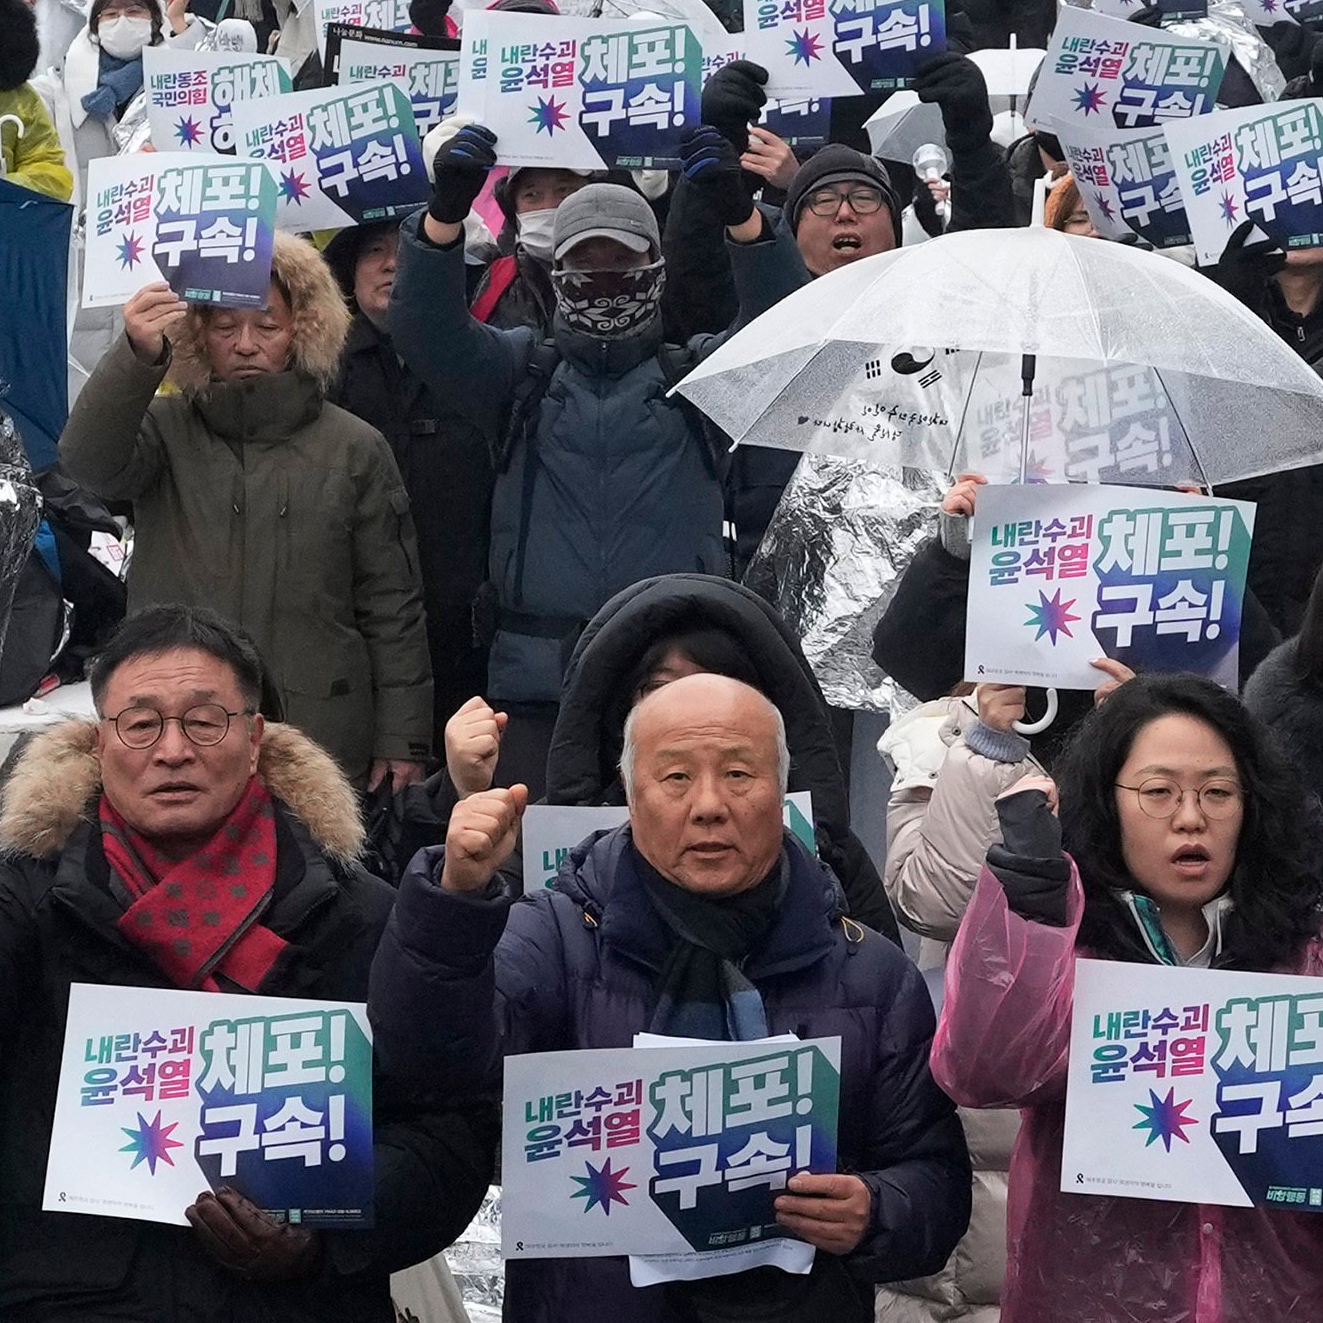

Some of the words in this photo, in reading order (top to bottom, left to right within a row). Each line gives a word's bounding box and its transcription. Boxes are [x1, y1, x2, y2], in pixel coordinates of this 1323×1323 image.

[306, 85, 400, 149] 체포!
[1234, 110, 1323, 173] 체포!
[318, 134, 414, 198] 구속!
[96, 197, 153, 237] 윤석열
[153, 214, 256, 267] 구속!
[990, 513, 1094, 548] 내란수괴
[1095, 506, 1230, 576] 체포!
[988, 542, 1089, 587] 윤석열
[1094, 580, 1224, 649] 구속!
[82, 1024, 195, 1066] 내란수괴
[1091, 1003, 1210, 1042] 내란수괴
[79, 1057, 192, 1108] 윤석열
[1090, 1035, 1207, 1084] 윤석열
[523, 1077, 644, 1123] 내란수괴
[650, 1051, 815, 1140] 체포!
[197, 1094, 347, 1179] 구속!
[523, 1108, 641, 1162] 윤석열
[655, 1125, 812, 1212] 구속!
